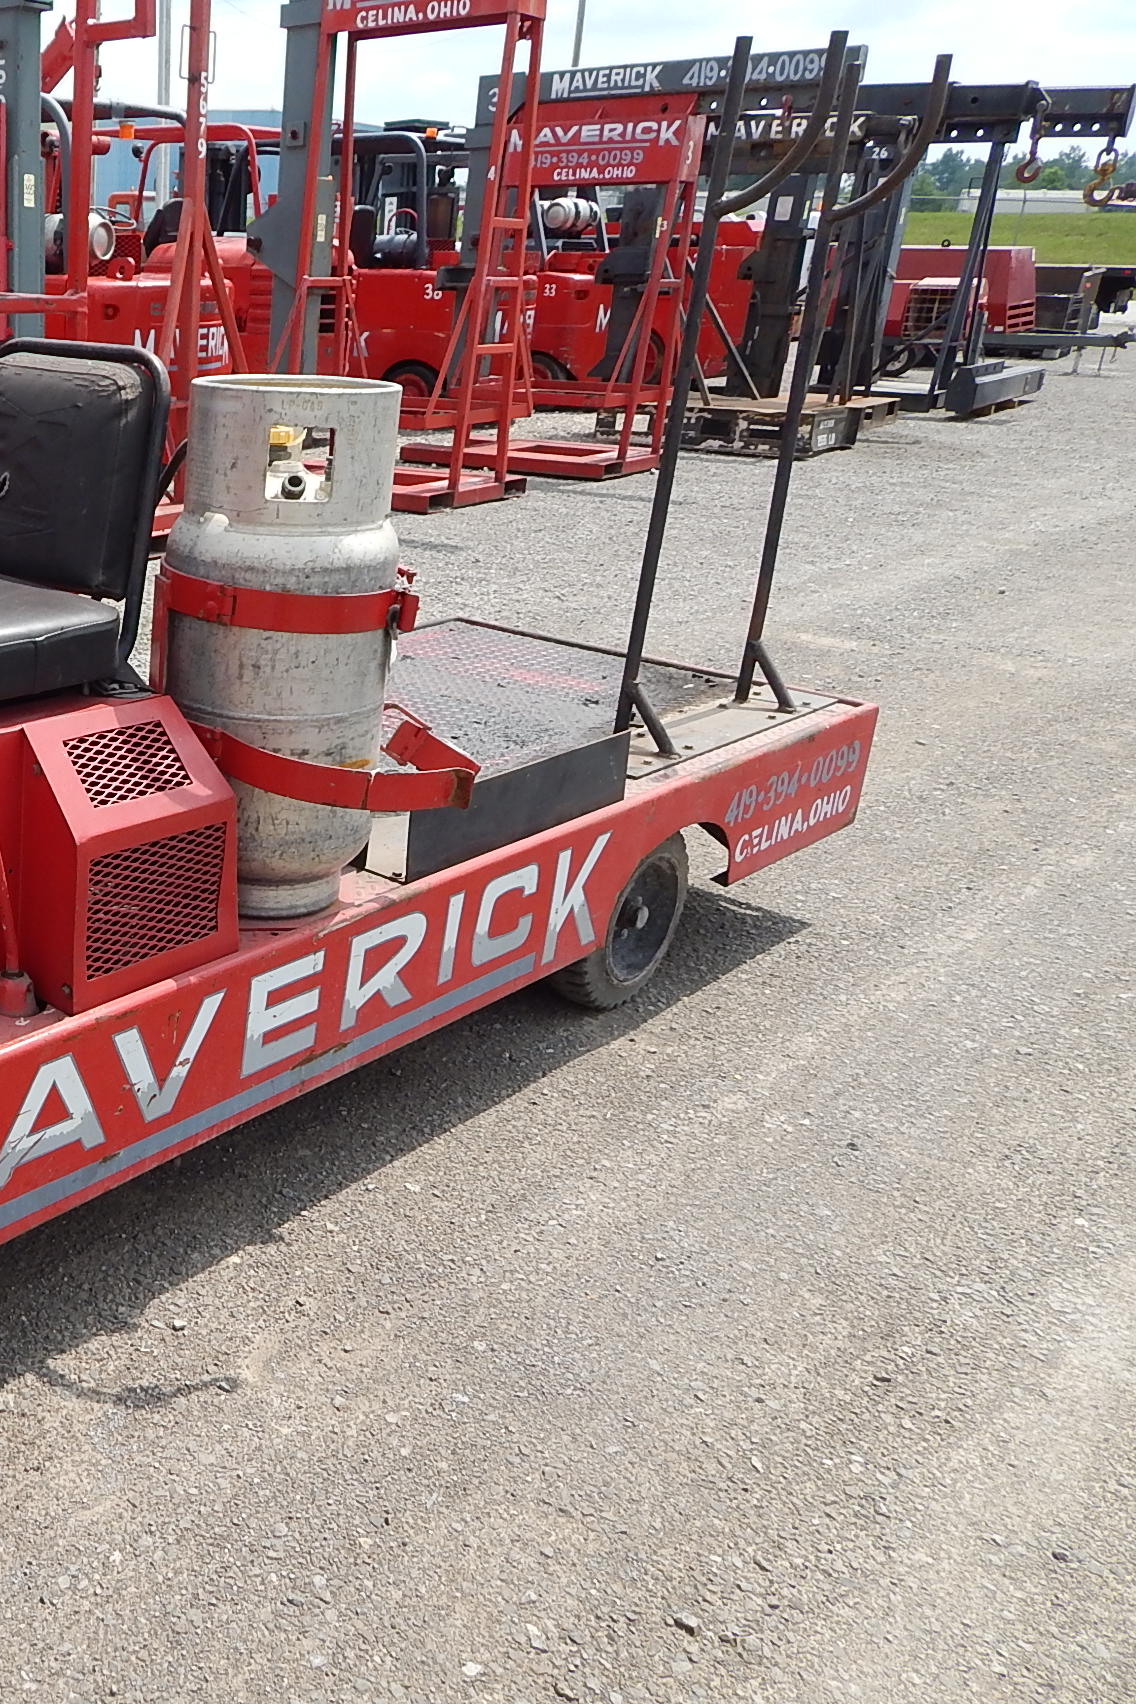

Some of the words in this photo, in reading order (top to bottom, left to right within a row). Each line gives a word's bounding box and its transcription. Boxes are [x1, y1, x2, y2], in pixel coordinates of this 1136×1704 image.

[550, 64, 664, 99] MAVERICK
[706, 116, 866, 141] MAVERCK
[871, 147, 888, 160] 26
[543, 283, 557, 297] 33
